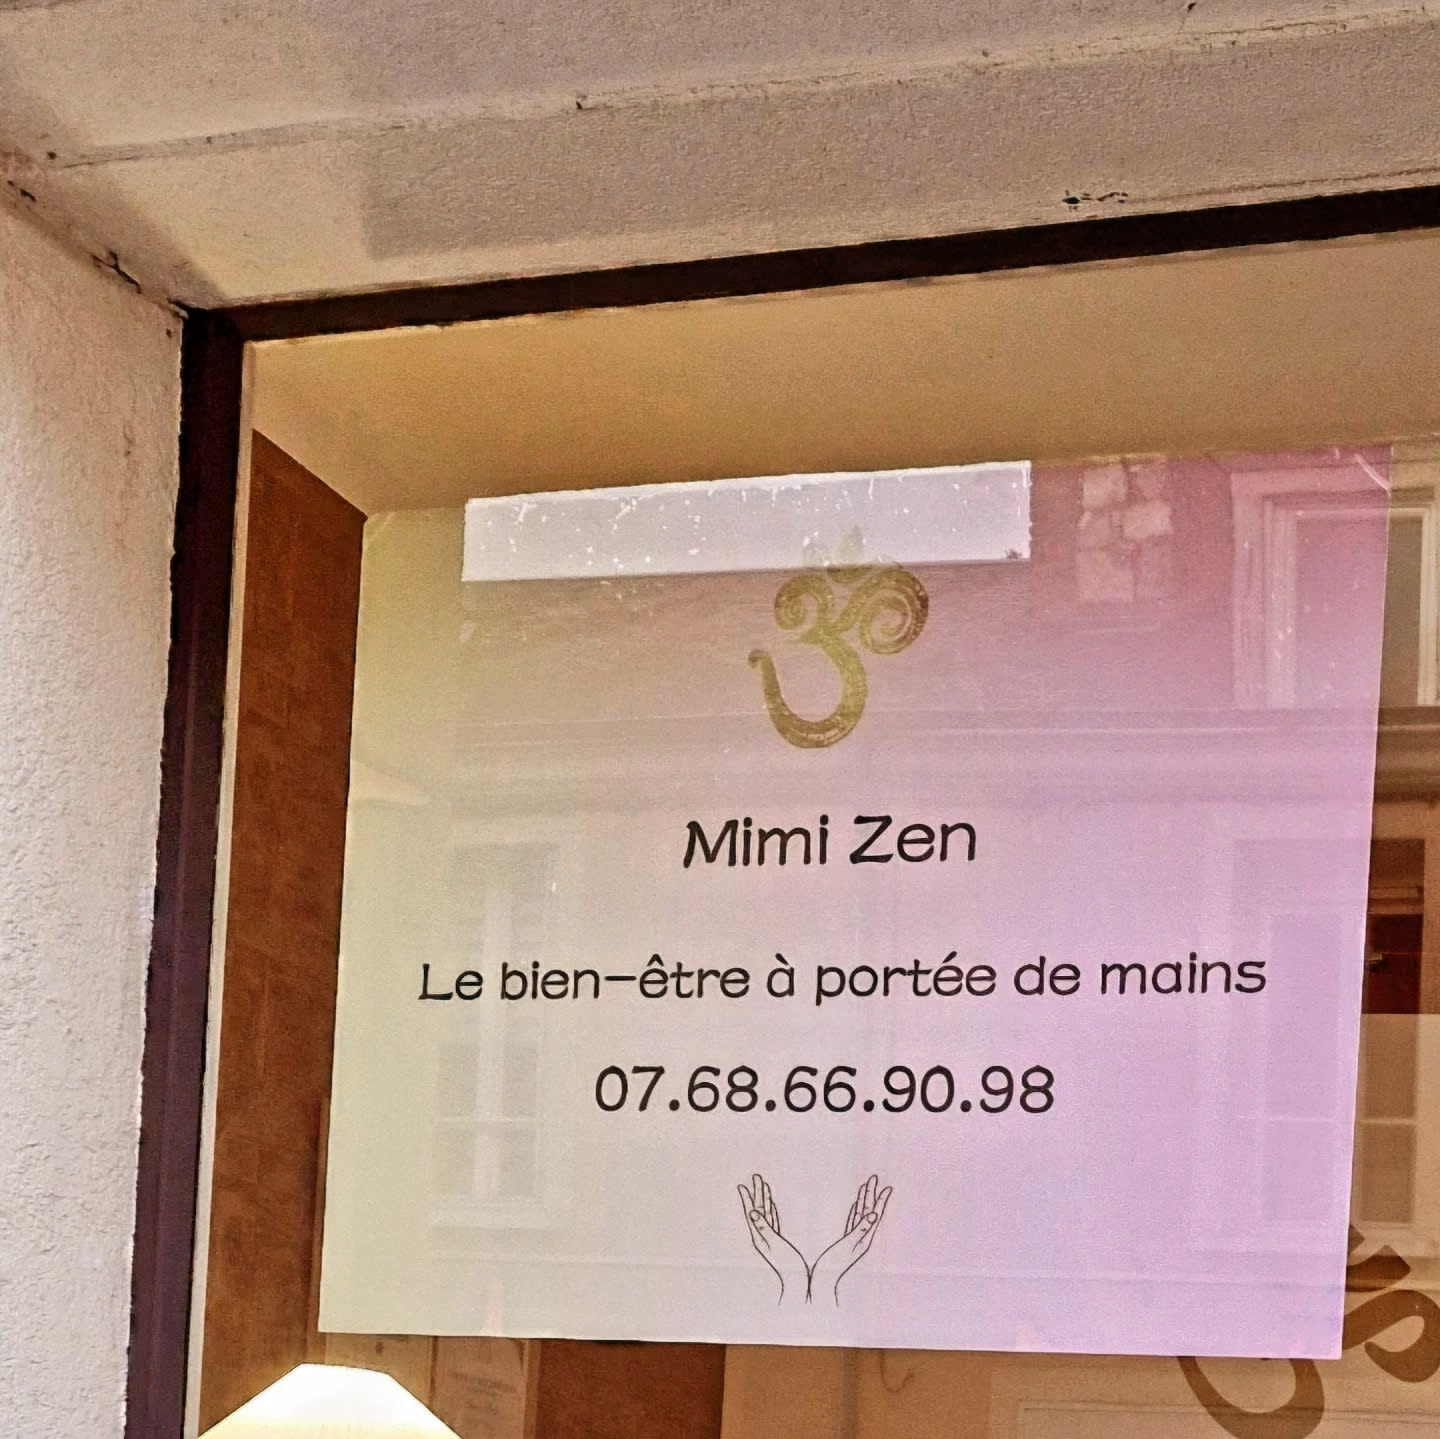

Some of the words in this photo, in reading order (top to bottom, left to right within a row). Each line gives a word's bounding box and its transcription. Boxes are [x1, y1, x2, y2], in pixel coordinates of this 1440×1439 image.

[682, 813, 830, 869] Mimi
[849, 814, 977, 865] Zen
[417, 963, 484, 1001] Le
[500, 953, 751, 1001] bien-être
[766, 952, 795, 999] à
[815, 950, 997, 1007] portée
[1013, 955, 1081, 997] de
[1100, 951, 1267, 996] mains
[595, 1064, 1055, 1114] 07.68.66.90.98
